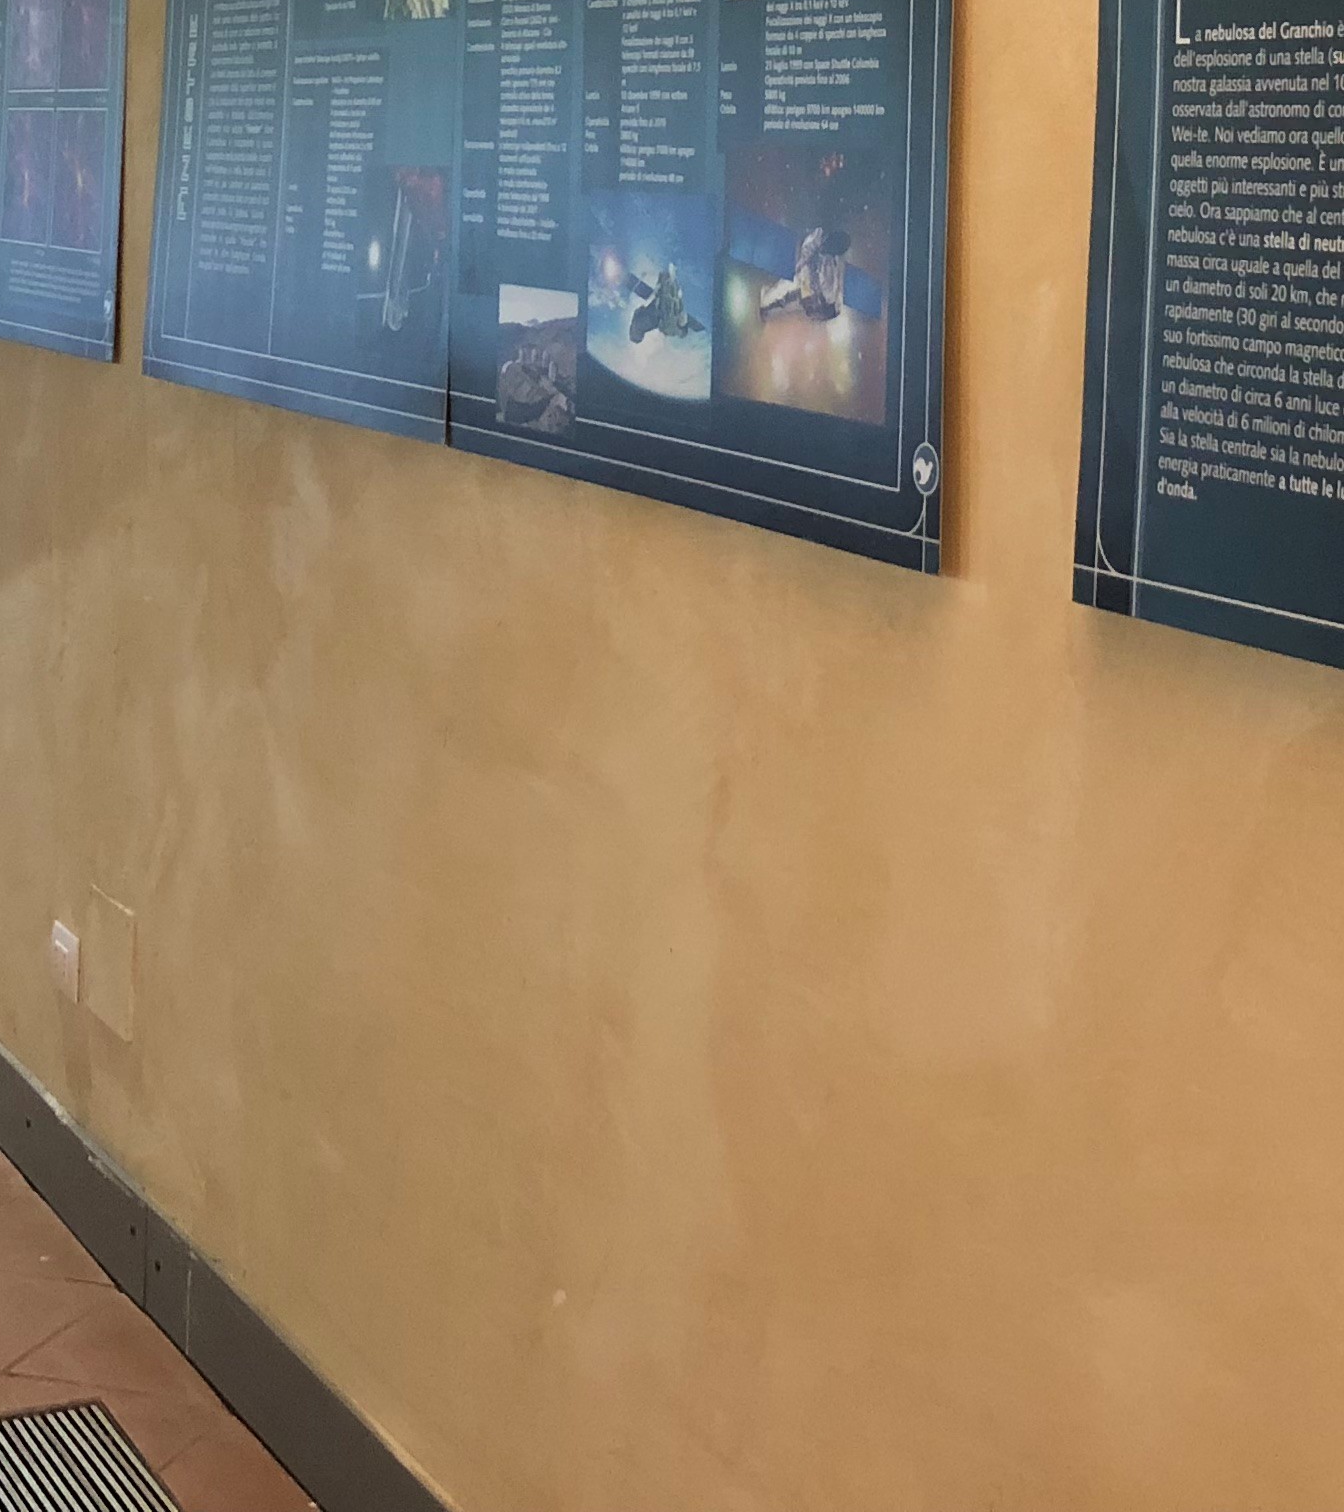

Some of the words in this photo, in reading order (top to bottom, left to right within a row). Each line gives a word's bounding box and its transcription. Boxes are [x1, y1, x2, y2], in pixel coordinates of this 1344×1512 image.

[1203, 22, 1256, 41] nebulosa
[1257, 20, 1276, 40] del
[1279, 19, 1334, 39] Granchio
[1336, 19, 1344, 37] è
[1254, 47, 1266, 65] di
[1268, 51, 1291, 66] una
[1294, 46, 1324, 65] stella
[1172, 75, 1207, 92] nostra
[1208, 73, 1252, 97] galassia
[1254, 74, 1308, 92] avvenuta
[1310, 71, 1329, 91] nel
[1171, 100, 1223, 117] osservata
[1312, 99, 1325, 118] di
[1214, 125, 1234, 143] Noi
[1236, 124, 1286, 144] vediamo
[1287, 130, 1308, 144] ora
[1170, 149, 1203, 172] quella
[1204, 154, 1248, 169] enorme
[1317, 149, 1326, 171] È
[1169, 176, 1208, 198] oggetti
[1210, 176, 1228, 198] più
[1230, 177, 1296, 197] interessanti
[1298, 183, 1307, 197] e
[1309, 179, 1329, 203] più
[1198, 200, 1222, 219] Ora
[1223, 206, 1280, 226] sappiamo
[1280, 203, 1303, 224] che
[1305, 205, 1317, 225] al
[1167, 225, 1216, 245] nebulosa
[1238, 233, 1260, 248] una
[1262, 230, 1295, 250] stella
[1297, 231, 1310, 250] di
